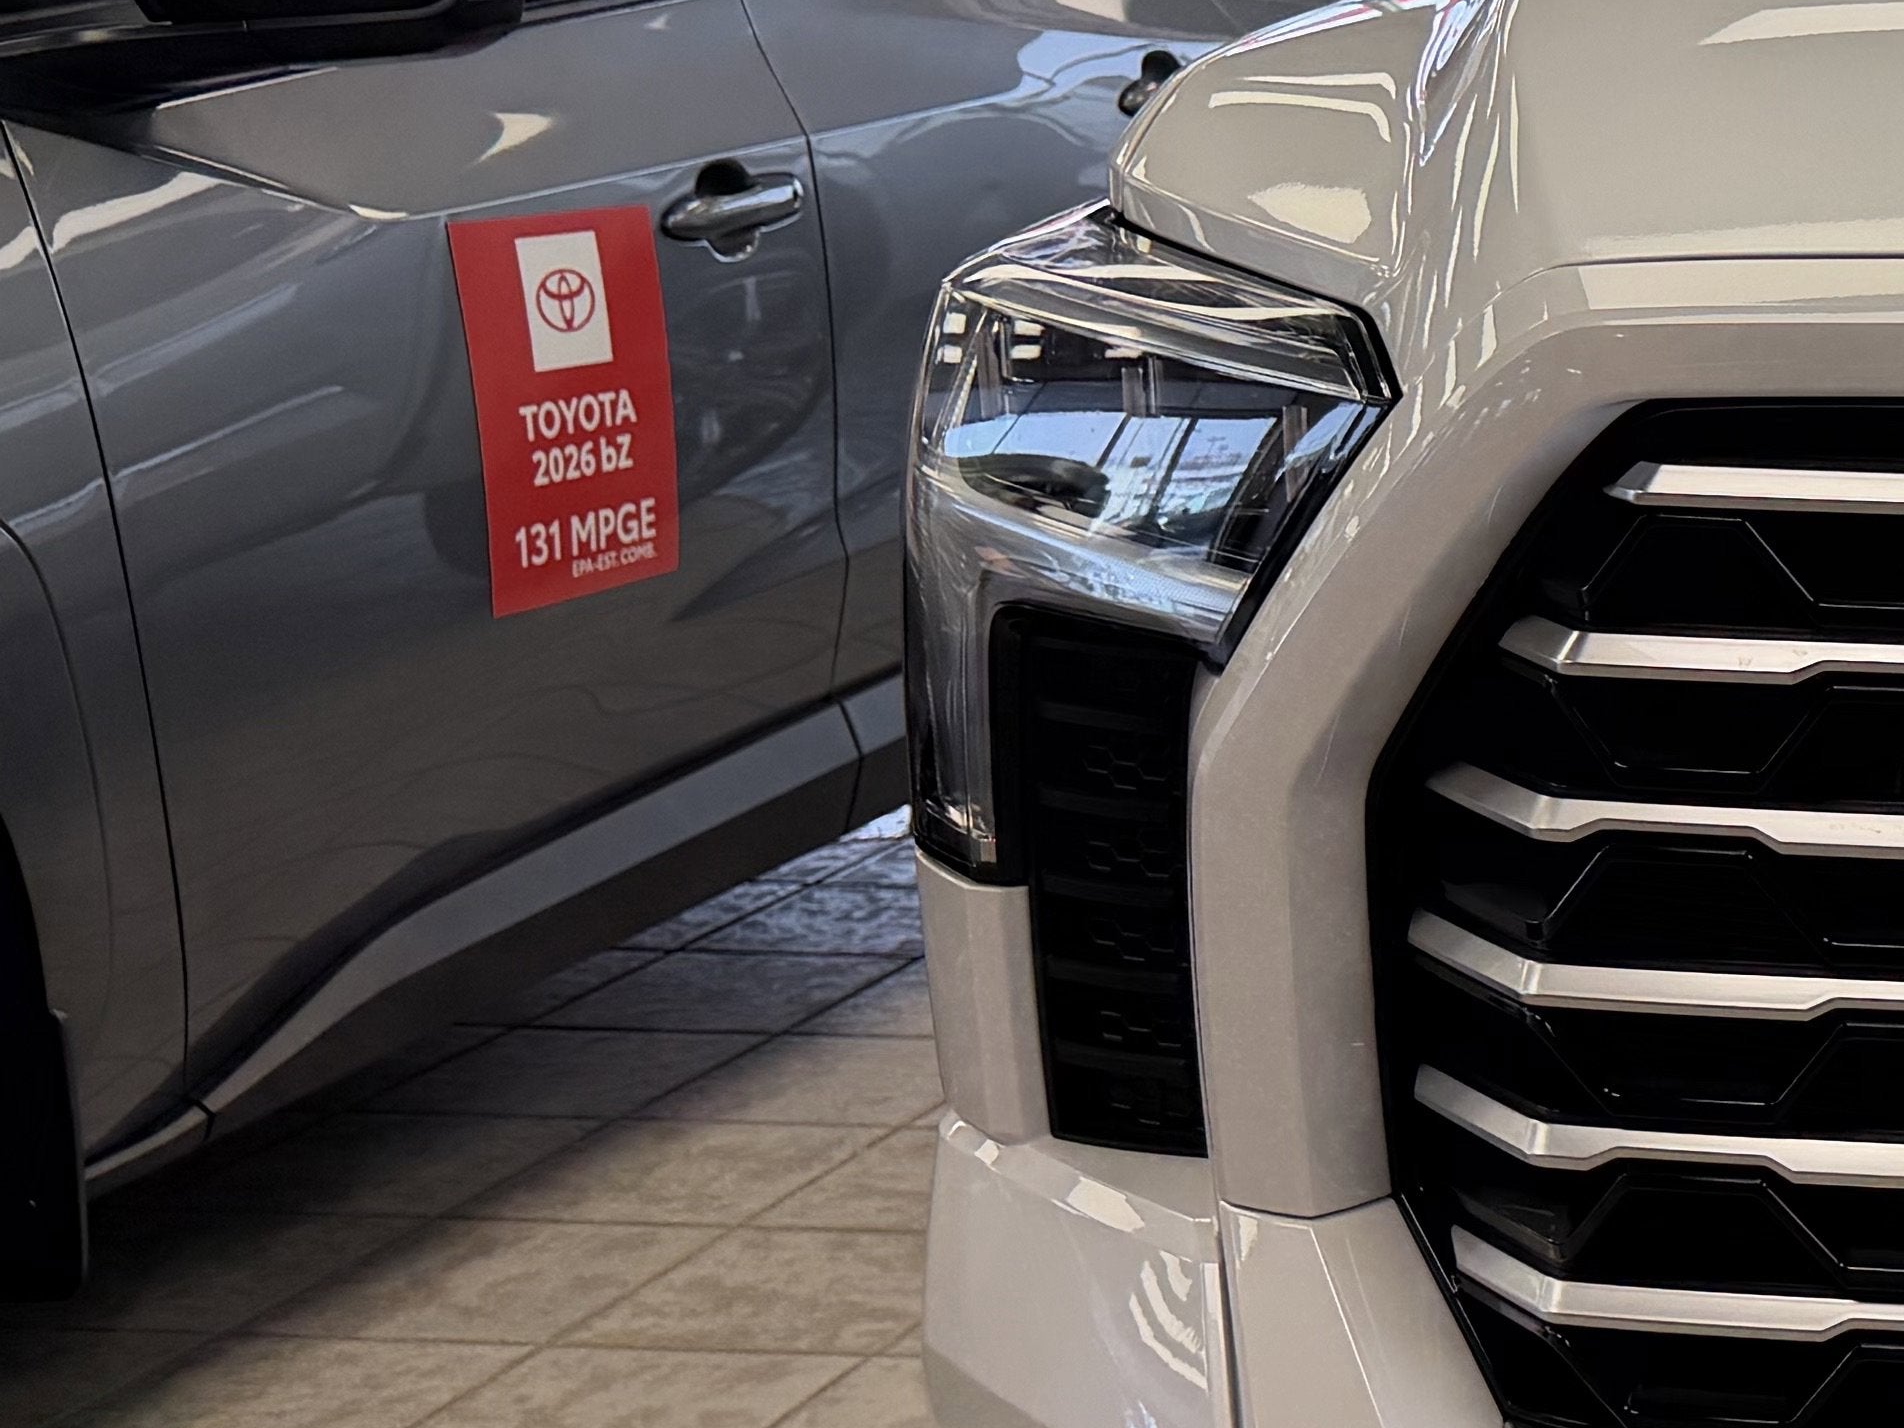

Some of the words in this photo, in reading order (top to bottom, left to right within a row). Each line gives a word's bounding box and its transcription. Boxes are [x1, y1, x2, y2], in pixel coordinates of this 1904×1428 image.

[519, 388, 637, 442] TOYOTA
[532, 440, 597, 487] 2026
[599, 432, 634, 471] bZ
[514, 519, 562, 569] 131
[570, 496, 657, 557] MPGE
